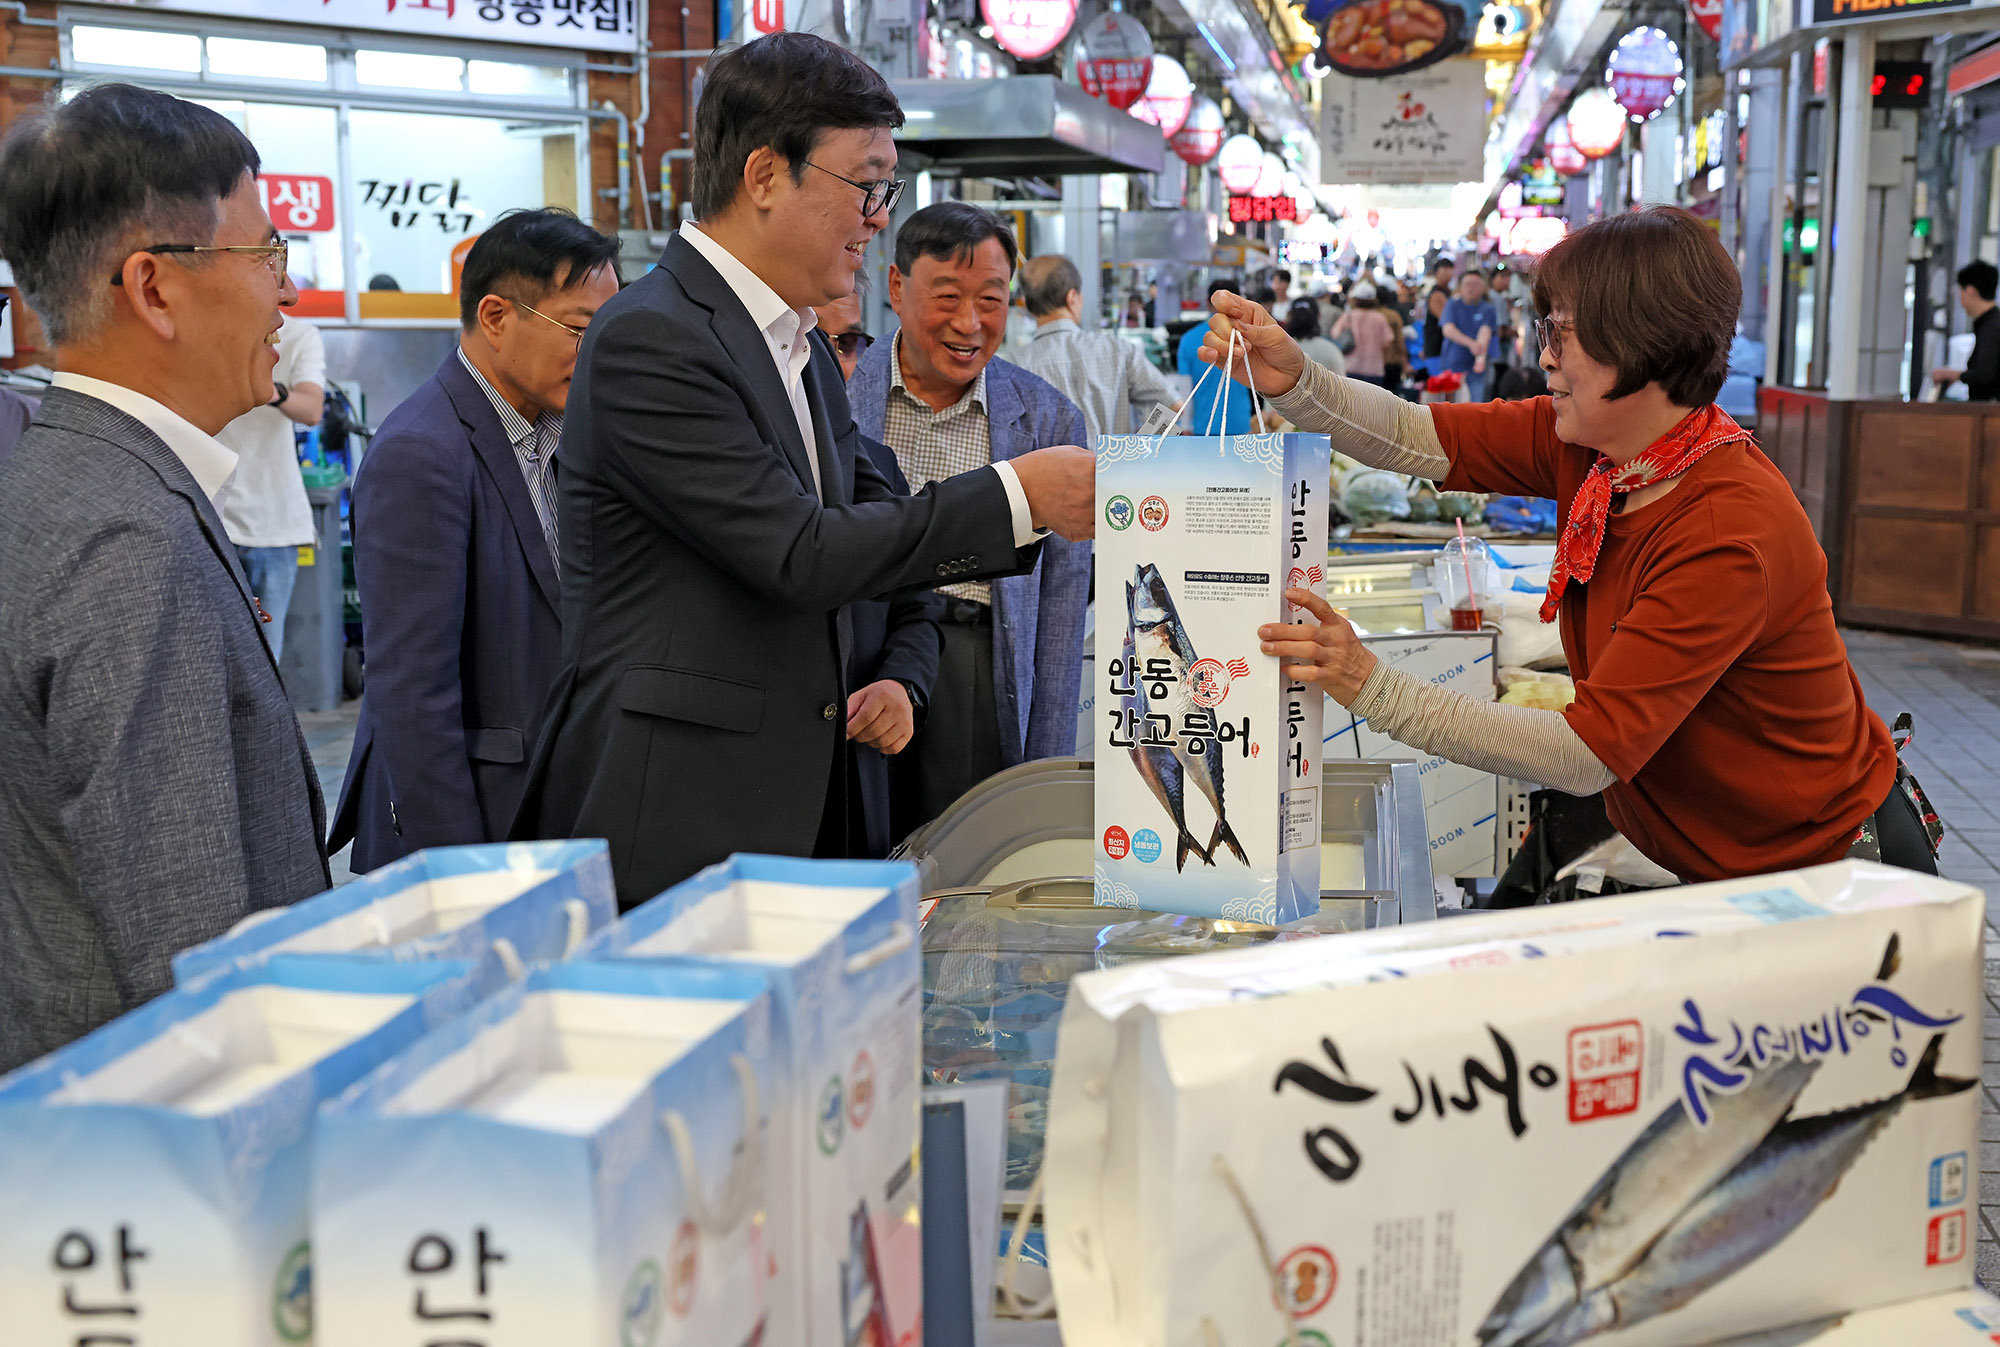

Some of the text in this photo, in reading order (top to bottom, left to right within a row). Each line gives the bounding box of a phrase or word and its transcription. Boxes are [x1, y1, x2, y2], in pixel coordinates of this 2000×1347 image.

[257, 179, 321, 228] 생
[358, 178, 474, 233] 찜닭
[1109, 656, 1178, 699] 안동
[1109, 710, 1250, 757] 간고등어
[1271, 1020, 1560, 1186] 안동
[54, 1225, 147, 1347] 안
[409, 1227, 506, 1347] 안
